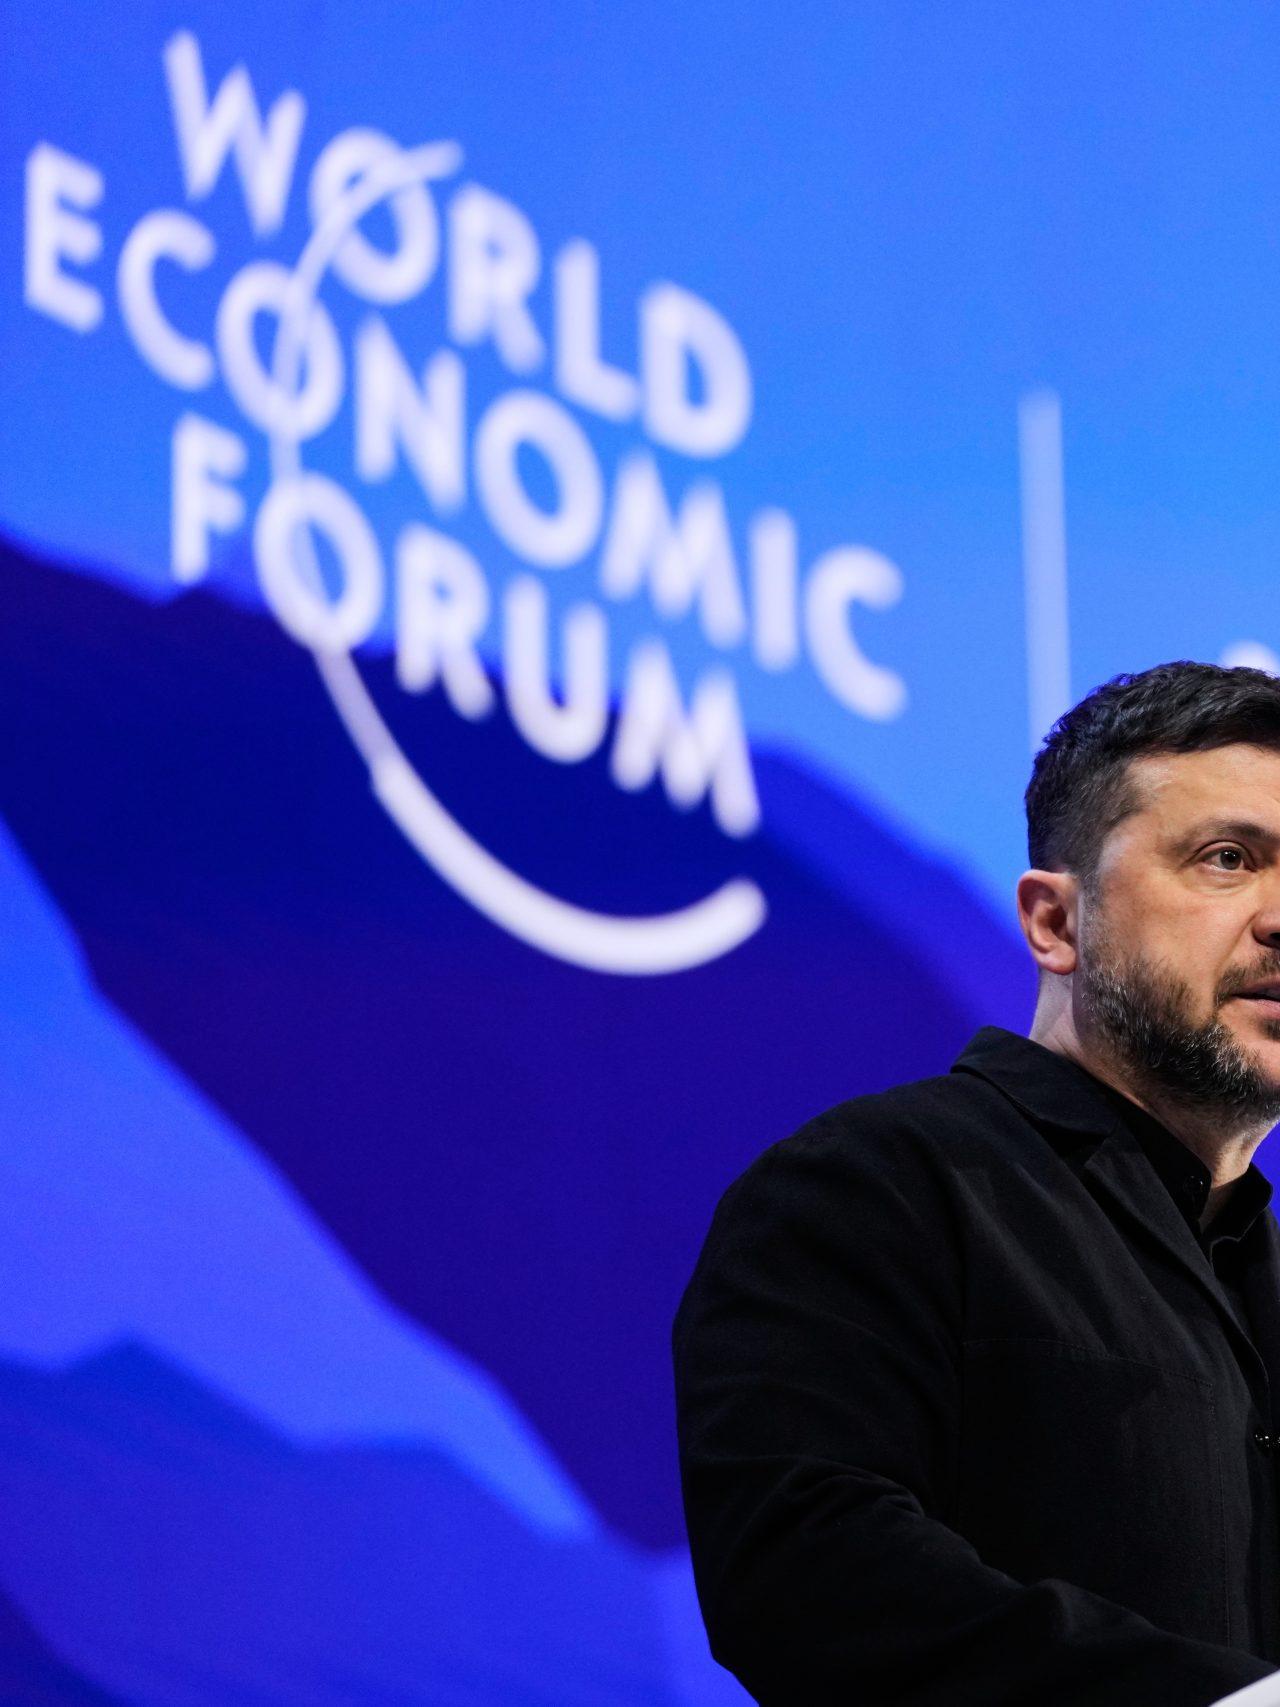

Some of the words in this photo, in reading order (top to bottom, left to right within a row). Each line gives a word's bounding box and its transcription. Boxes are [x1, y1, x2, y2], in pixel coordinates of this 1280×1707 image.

[23, 140, 908, 724] ECONOMIC
[163, 29, 753, 460] WORLD
[170, 411, 762, 839] FORUM
